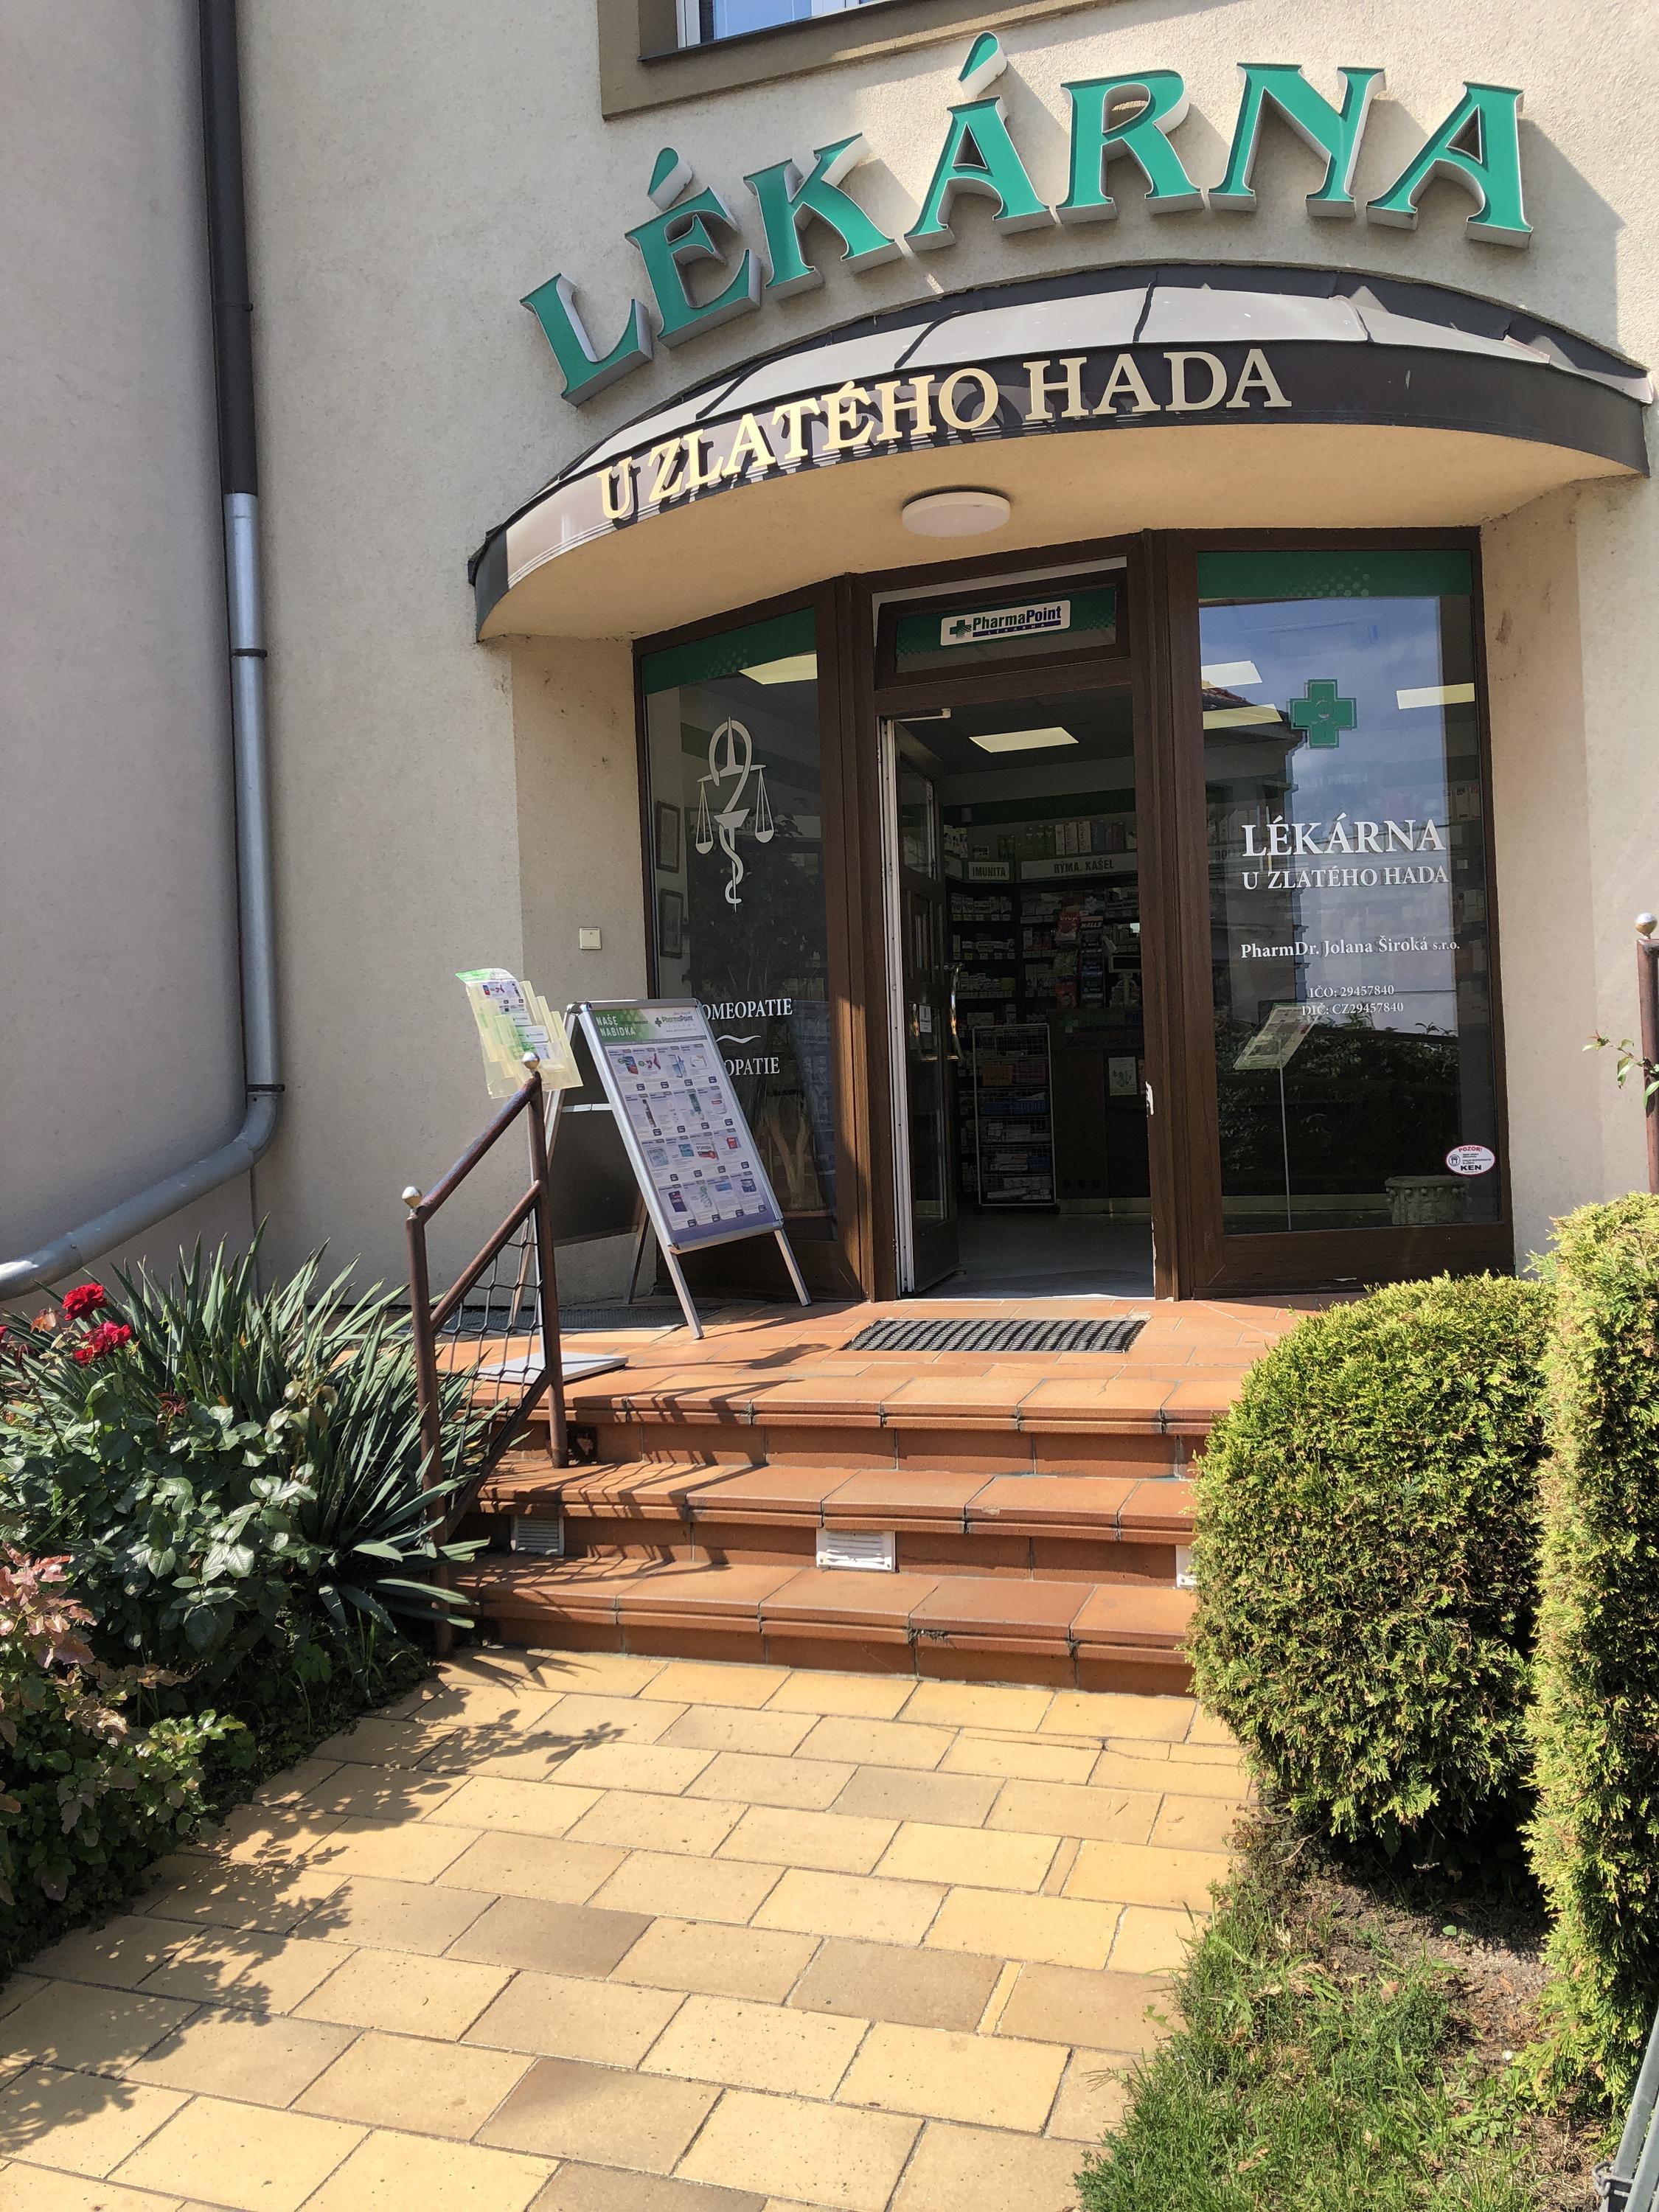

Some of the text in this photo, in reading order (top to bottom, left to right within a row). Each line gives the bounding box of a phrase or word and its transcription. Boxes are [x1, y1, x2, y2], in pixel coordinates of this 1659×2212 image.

[520, 32, 1533, 407] LÉKÁRNA
[596, 348, 1292, 519] U ZLATÉHO HADA
[973, 606, 1062, 631] PharmaPoint
[1241, 813, 1447, 857] LÉKÁRNA
[972, 866, 1006, 877] IMUNITA
[1085, 858, 1115, 871] KAŠEL
[1242, 865, 1450, 890] U ZLATÉHO HADA
[1240, 935, 1461, 959] PharmDr. Jolana Široká s.r.o.
[1310, 984, 1395, 998] IČO: 29457840
[596, 1014, 619, 1026] NAŠE
[702, 998, 793, 1020] OMEOPATIE
[1301, 1002, 1404, 1016] DIČ: CZ29457840
[600, 1026, 636, 1037] NABÍDKA
